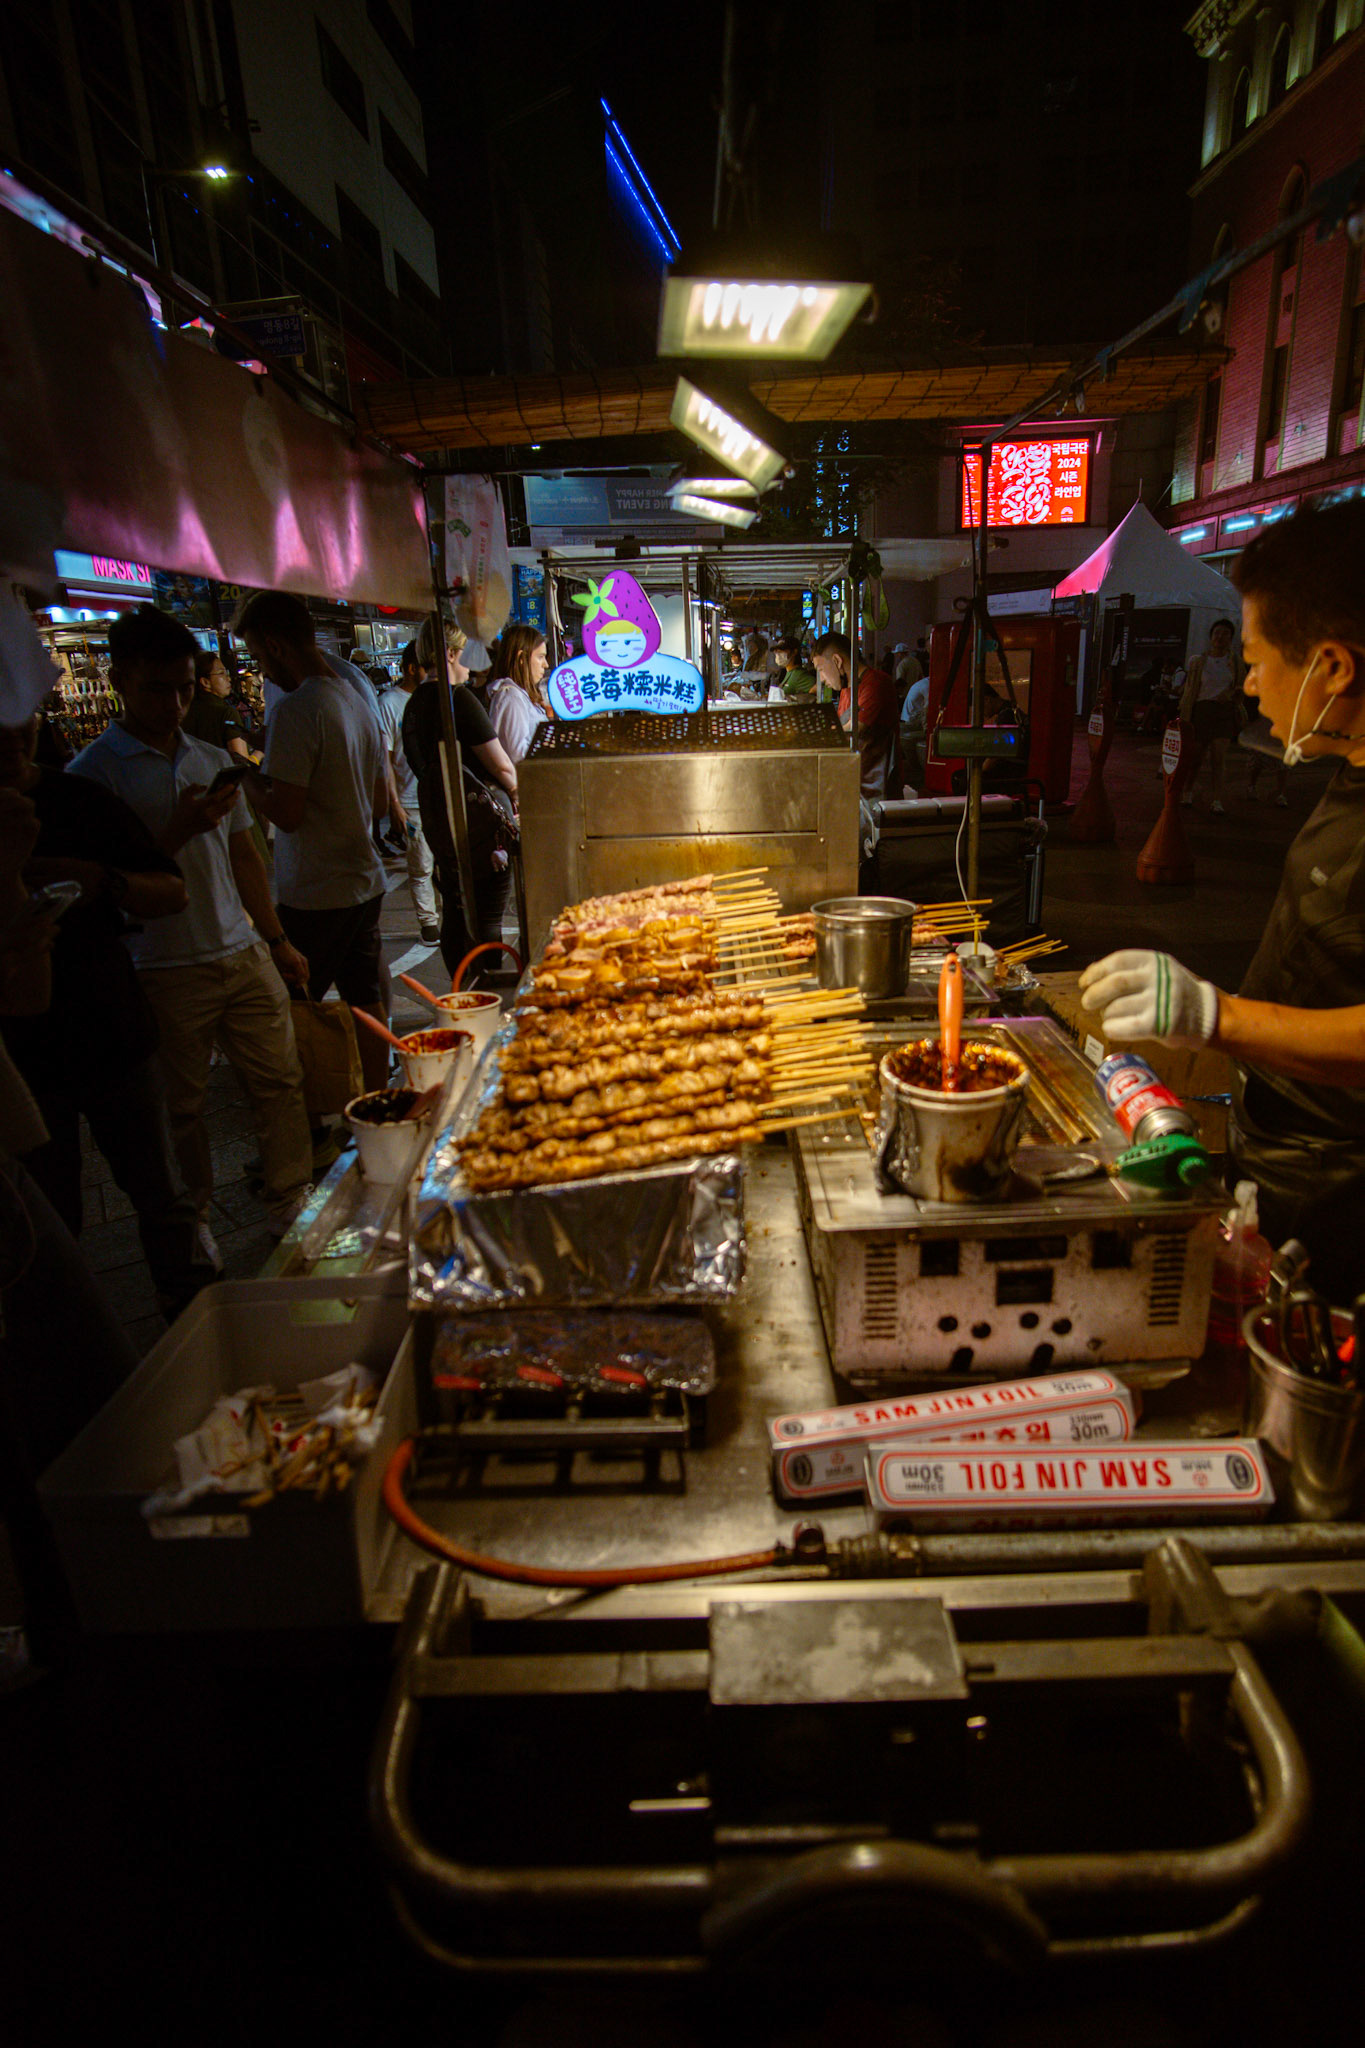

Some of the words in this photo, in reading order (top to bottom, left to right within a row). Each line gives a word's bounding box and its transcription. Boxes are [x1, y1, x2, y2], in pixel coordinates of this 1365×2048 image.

[1052, 442, 1088, 455] 국립극단
[1057, 457, 1082, 469] 2024
[1059, 471, 1078, 483] 시즌
[1054, 485, 1082, 498] 라인업
[91, 554, 136, 581] MASK
[579, 669, 697, 705] 草莓糯米糕
[853, 1404, 918, 1426] SAM
[930, 1395, 974, 1415] JIN
[984, 1386, 1043, 1407] FOIL
[1071, 1423, 1110, 1441] 30m
[901, 1464, 944, 1482] 30m
[958, 1462, 1025, 1491] FOIL
[1035, 1460, 1087, 1490] JIN
[1099, 1458, 1171, 1489] SAM
